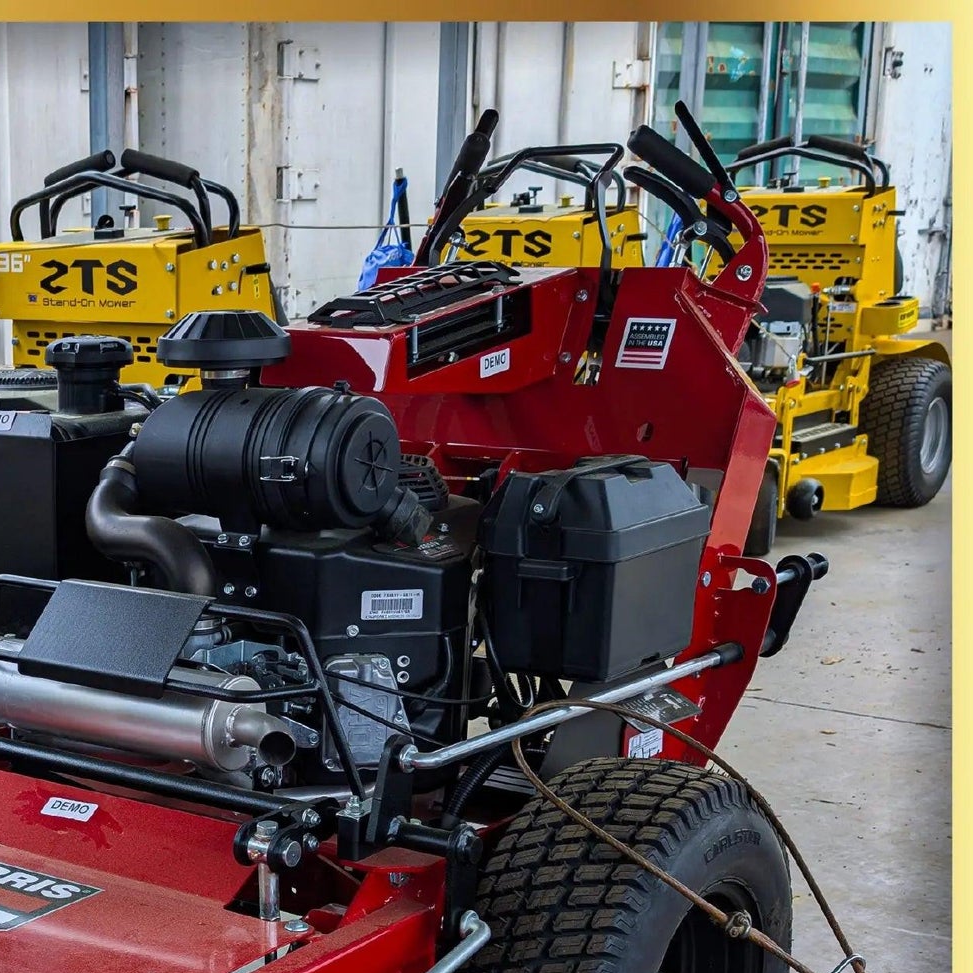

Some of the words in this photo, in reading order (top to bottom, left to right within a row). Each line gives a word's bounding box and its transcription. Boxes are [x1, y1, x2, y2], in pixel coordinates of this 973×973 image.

[42, 297, 95, 308] Stand-On
[99, 298, 136, 308] Mower
[484, 352, 507, 370] DEMO
[51, 800, 90, 815] DEMO
